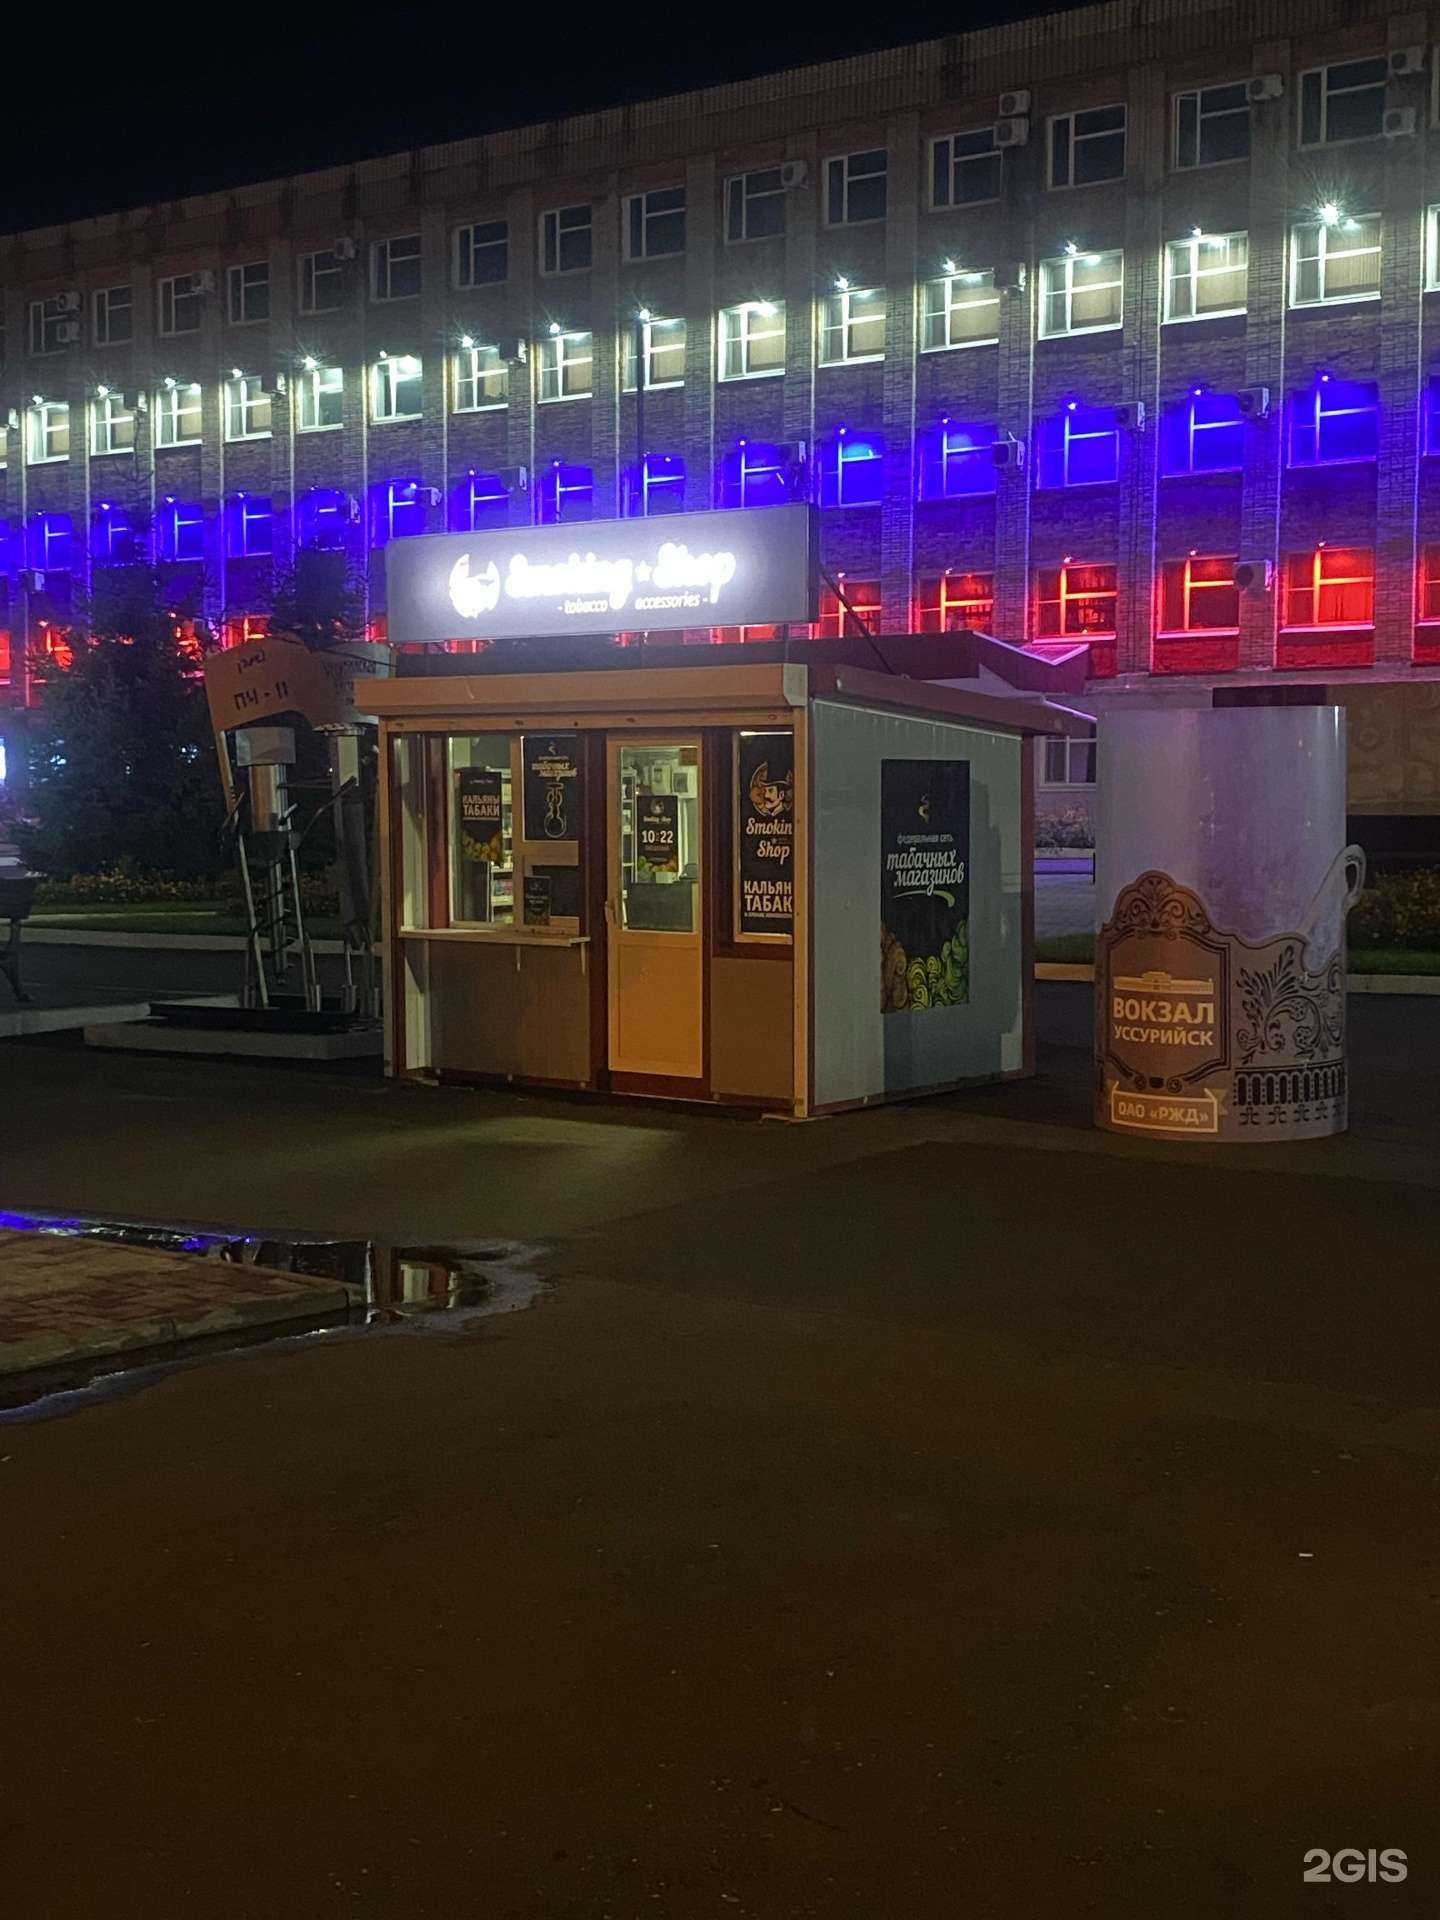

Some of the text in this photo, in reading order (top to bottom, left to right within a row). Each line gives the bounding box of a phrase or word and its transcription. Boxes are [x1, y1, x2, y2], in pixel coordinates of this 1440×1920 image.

[463, 805, 500, 816] ТАБАКИ
[757, 840, 790, 865] Shop
[886, 847, 957, 871] табачных
[744, 880, 792, 895] КАЛЬЯН
[894, 861, 965, 896] магазинов
[744, 895, 793, 912] ТАБАК
[1113, 997, 1215, 1024] ВОКЗАЛ
[1113, 1024, 1214, 1046] УССУРИЙСК
[1118, 1102, 1209, 1125] ОАО «РЖД»
